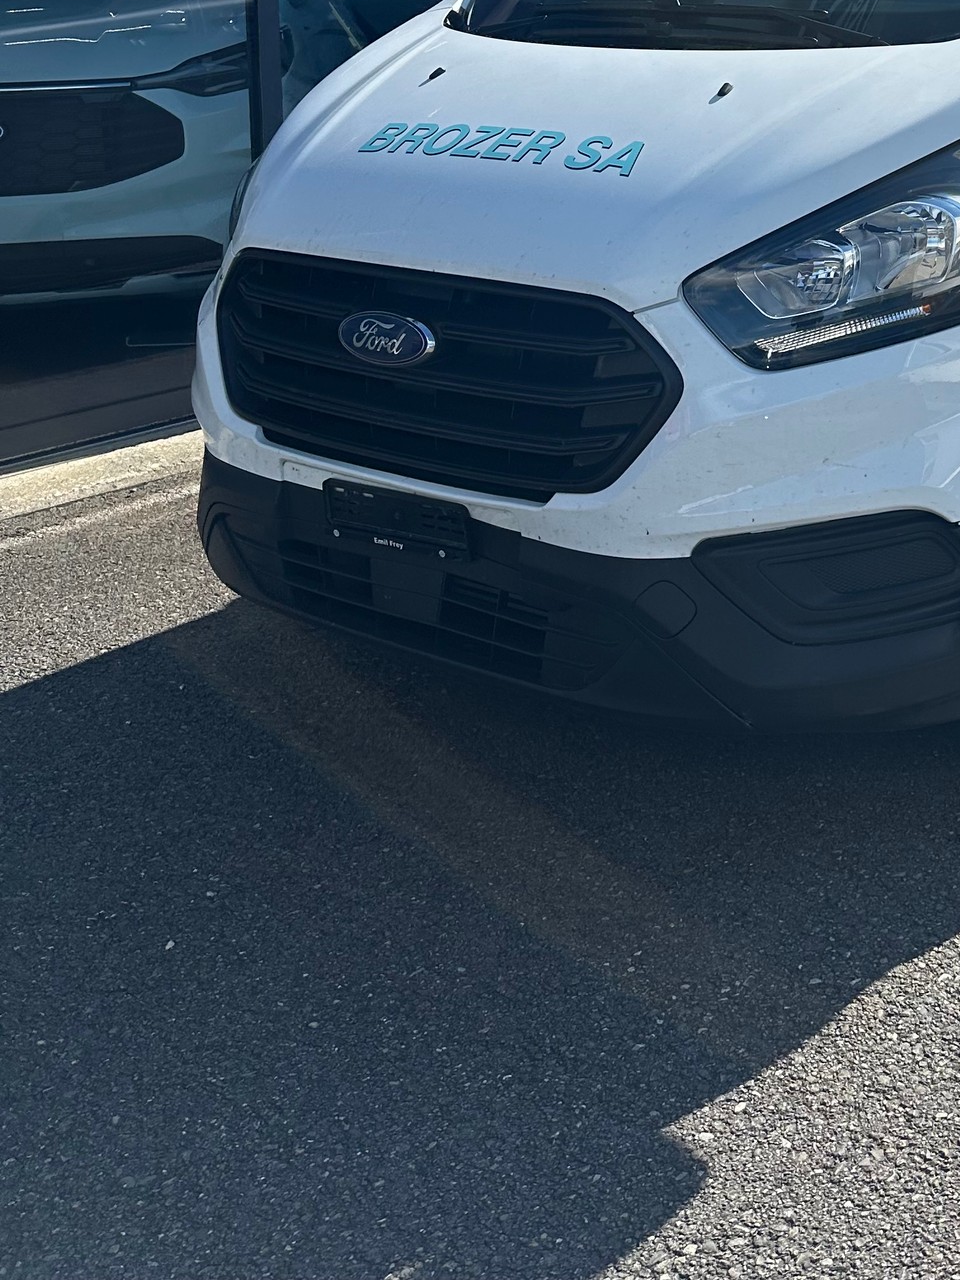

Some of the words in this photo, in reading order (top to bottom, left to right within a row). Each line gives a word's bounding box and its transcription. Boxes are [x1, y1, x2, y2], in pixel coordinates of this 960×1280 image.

[358, 122, 566, 166] BROZER
[563, 136, 646, 178] SA
[352, 317, 406, 356] Ford
[374, 536, 388, 545] Emil
[389, 540, 403, 550] Frey
